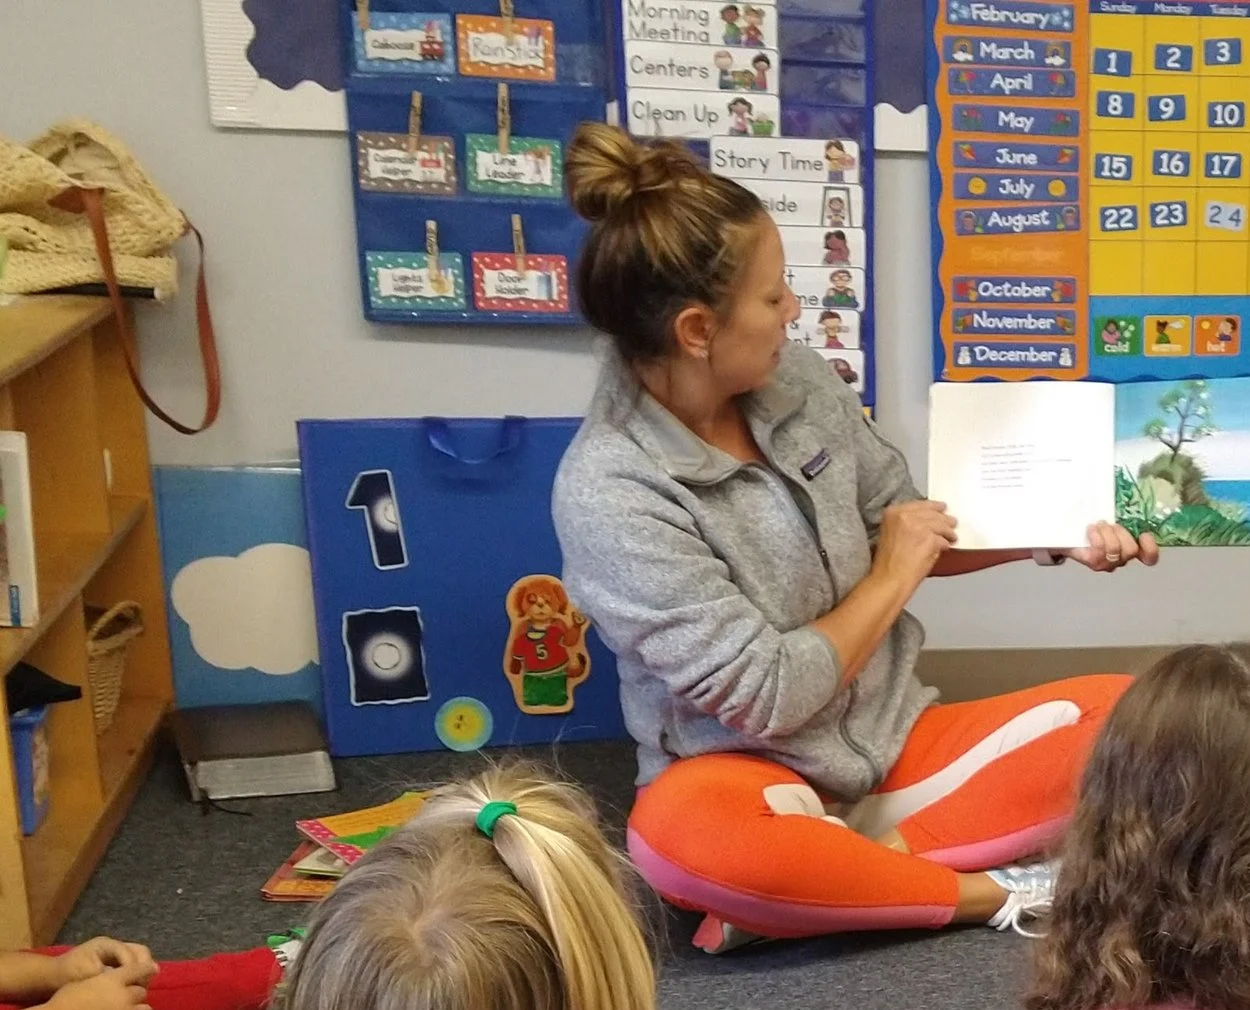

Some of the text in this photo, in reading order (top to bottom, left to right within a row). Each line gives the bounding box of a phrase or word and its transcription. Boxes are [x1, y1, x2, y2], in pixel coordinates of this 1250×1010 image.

[628, 0, 710, 27] Morning
[970, 3, 1050, 29] February
[1100, 1, 1138, 15] Sunday
[1153, 2, 1194, 16] Monday
[1209, 4, 1250, 17] Tuesday
[979, 41, 1036, 61] March
[1106, 52, 1118, 73] 1
[1165, 47, 1182, 68] 2
[1215, 41, 1231, 62] 3
[630, 55, 709, 79] Centers
[990, 73, 1034, 95] April
[632, 101, 719, 128] Clean Up
[1107, 94, 1124, 116] 8
[1158, 97, 1175, 120] 9
[1213, 104, 1241, 126] 10
[998, 110, 1035, 133] May
[491, 154, 517, 167] Line
[714, 149, 825, 172] Story Time
[995, 148, 1039, 166] June
[1100, 155, 1128, 178] 15
[1158, 152, 1185, 175] 16
[1210, 154, 1238, 176] 17
[484, 167, 526, 180] Leader
[998, 178, 1036, 199] July
[987, 209, 1051, 233] August
[1103, 203, 1243, 229] 22 23 24
[978, 281, 1053, 299] October
[972, 310, 1057, 330] November
[973, 345, 1058, 363] December
[1103, 341, 1131, 353] cold
[1206, 340, 1226, 353] hot
[535, 643, 549, 661] 5
